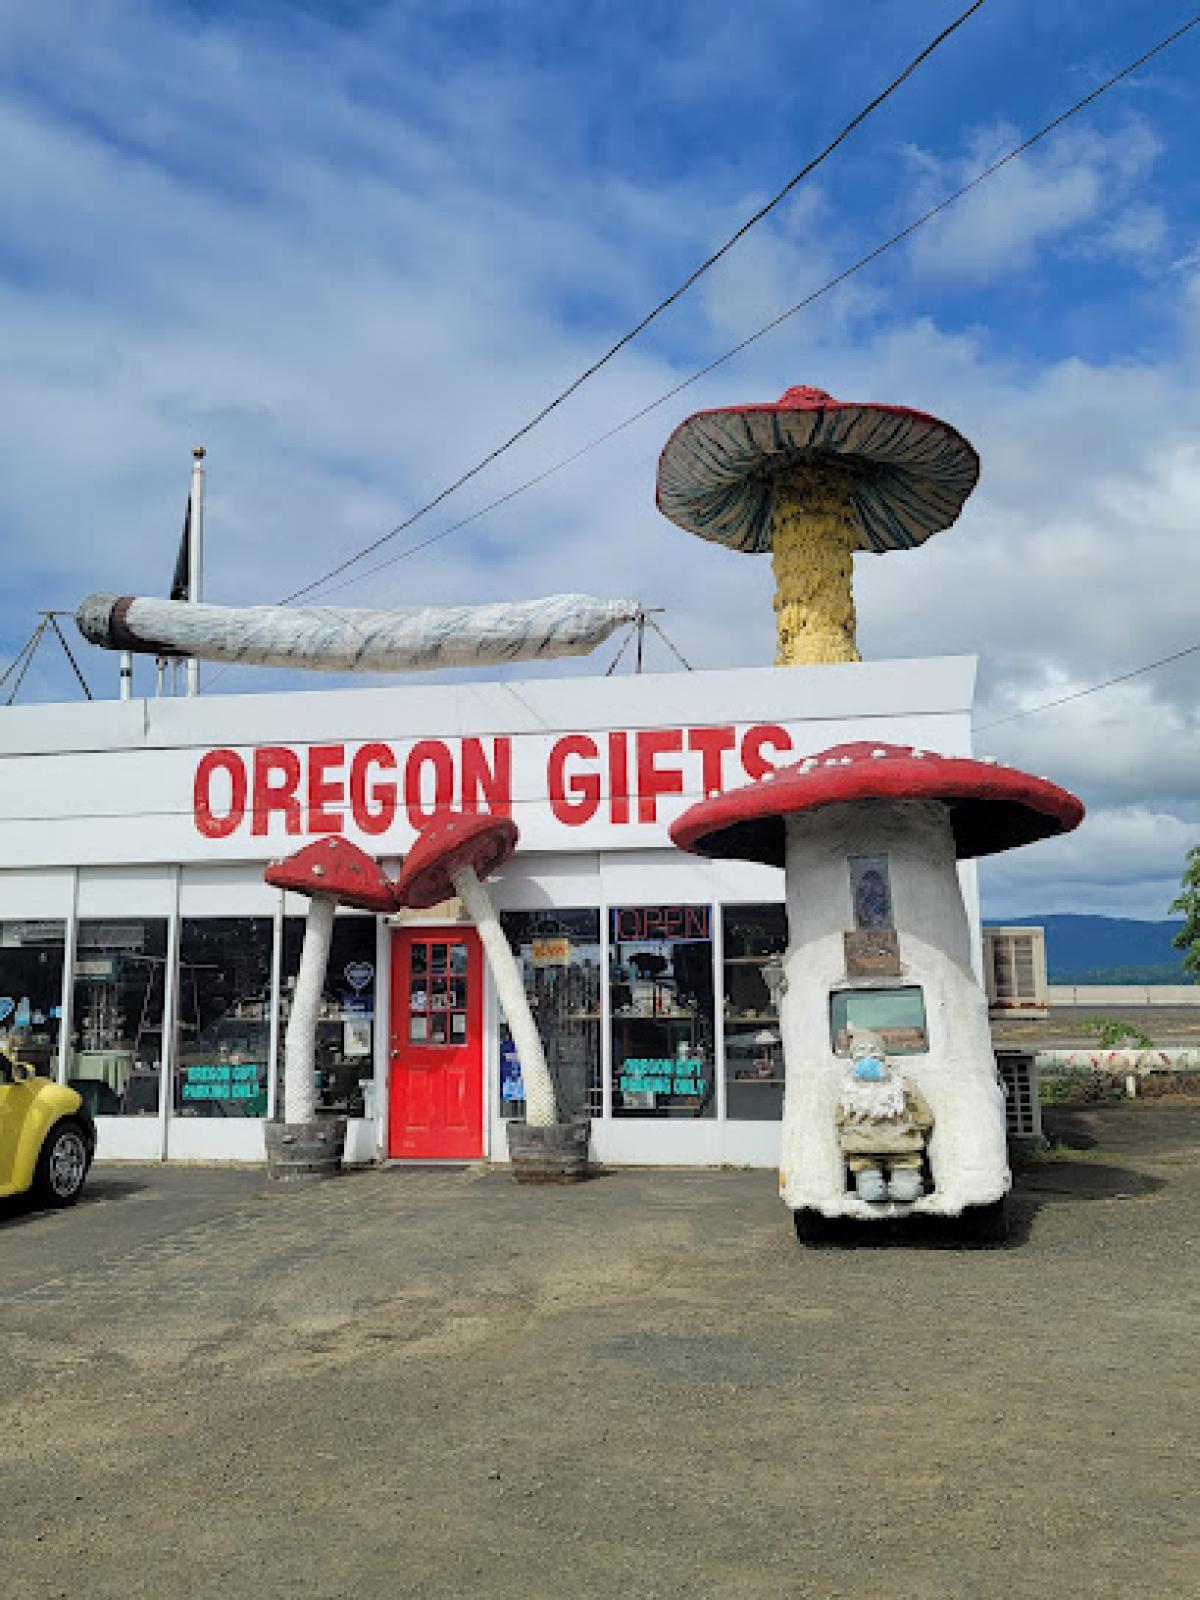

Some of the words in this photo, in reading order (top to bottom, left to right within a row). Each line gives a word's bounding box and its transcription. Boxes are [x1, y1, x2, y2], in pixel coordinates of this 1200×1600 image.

[193, 737, 512, 838] OREGON
[617, 907, 708, 939] OPEN
[623, 1058, 673, 1075] OREGON
[673, 1078, 704, 1095] ONLY
